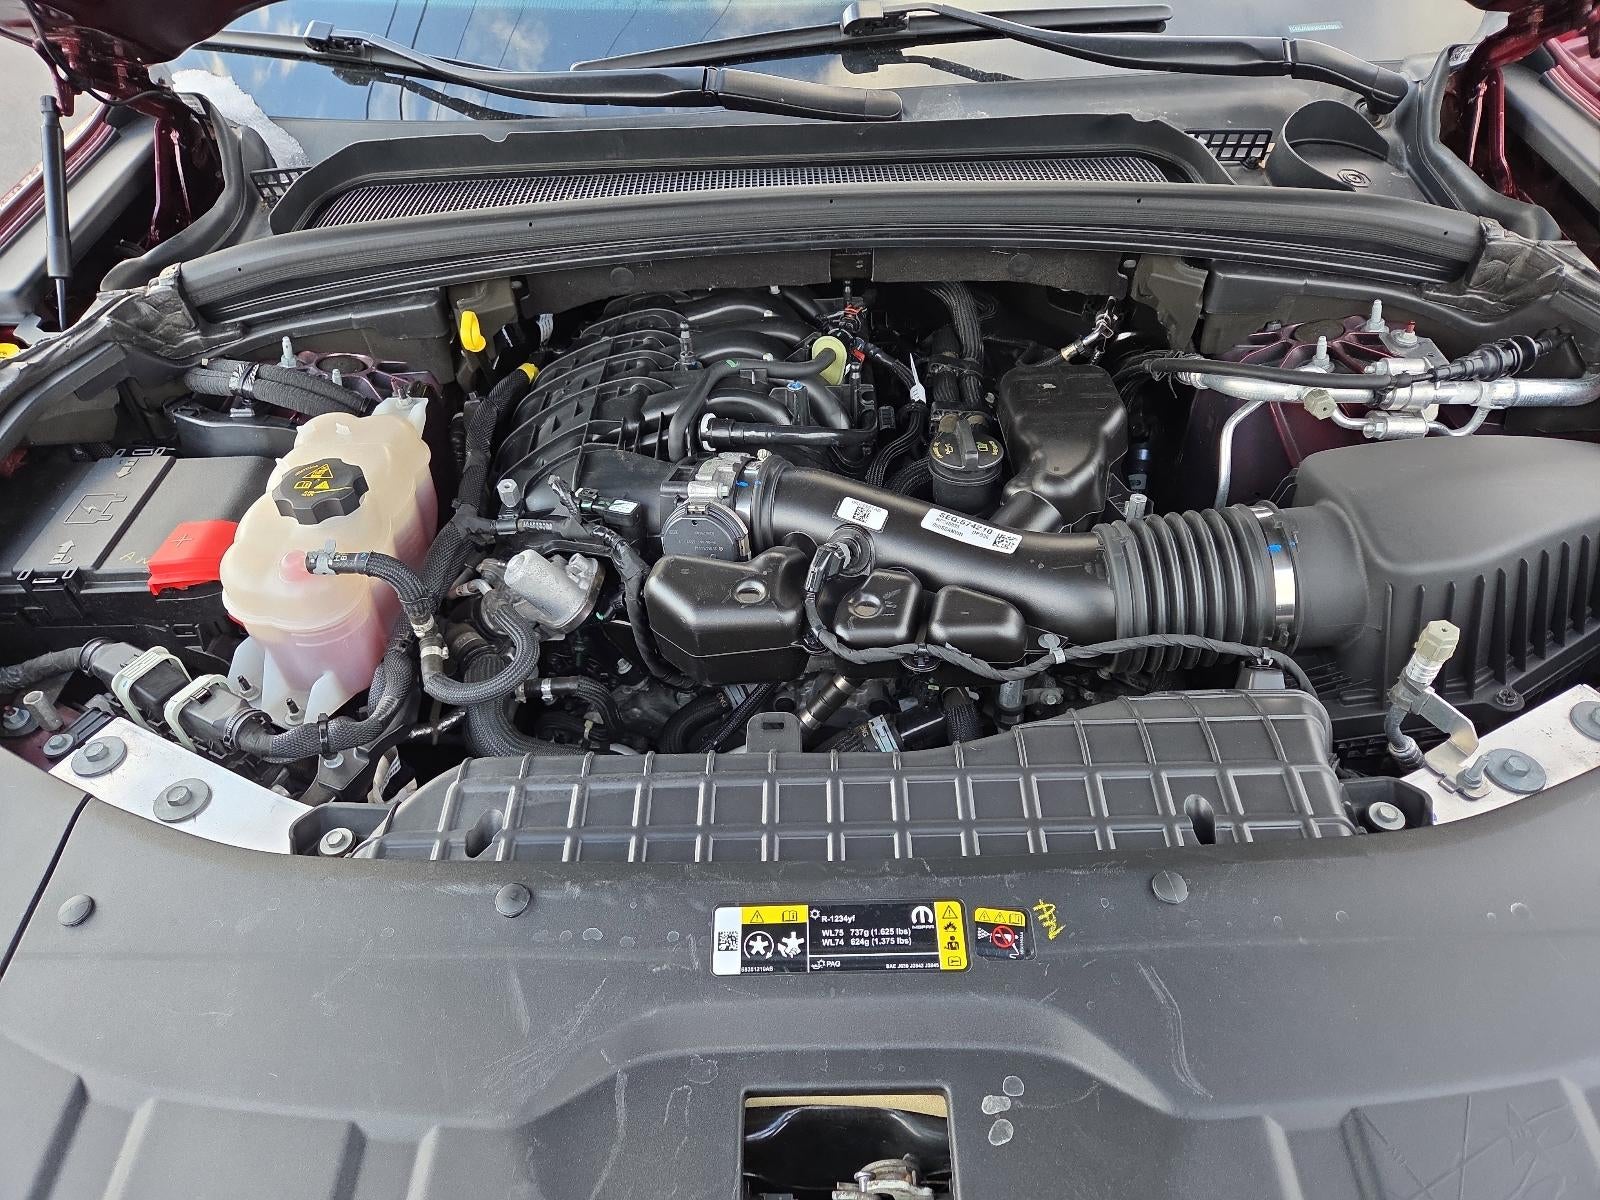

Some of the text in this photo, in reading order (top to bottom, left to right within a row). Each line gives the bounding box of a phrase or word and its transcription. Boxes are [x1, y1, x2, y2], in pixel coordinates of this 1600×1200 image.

[821, 915, 856, 923] R-1234yf
[821, 927, 912, 937] WL75 737g (1.625 lbs)
[821, 937, 912, 946] WL74 624g (1.375 lbs)
[826, 960, 841, 968] PAG
